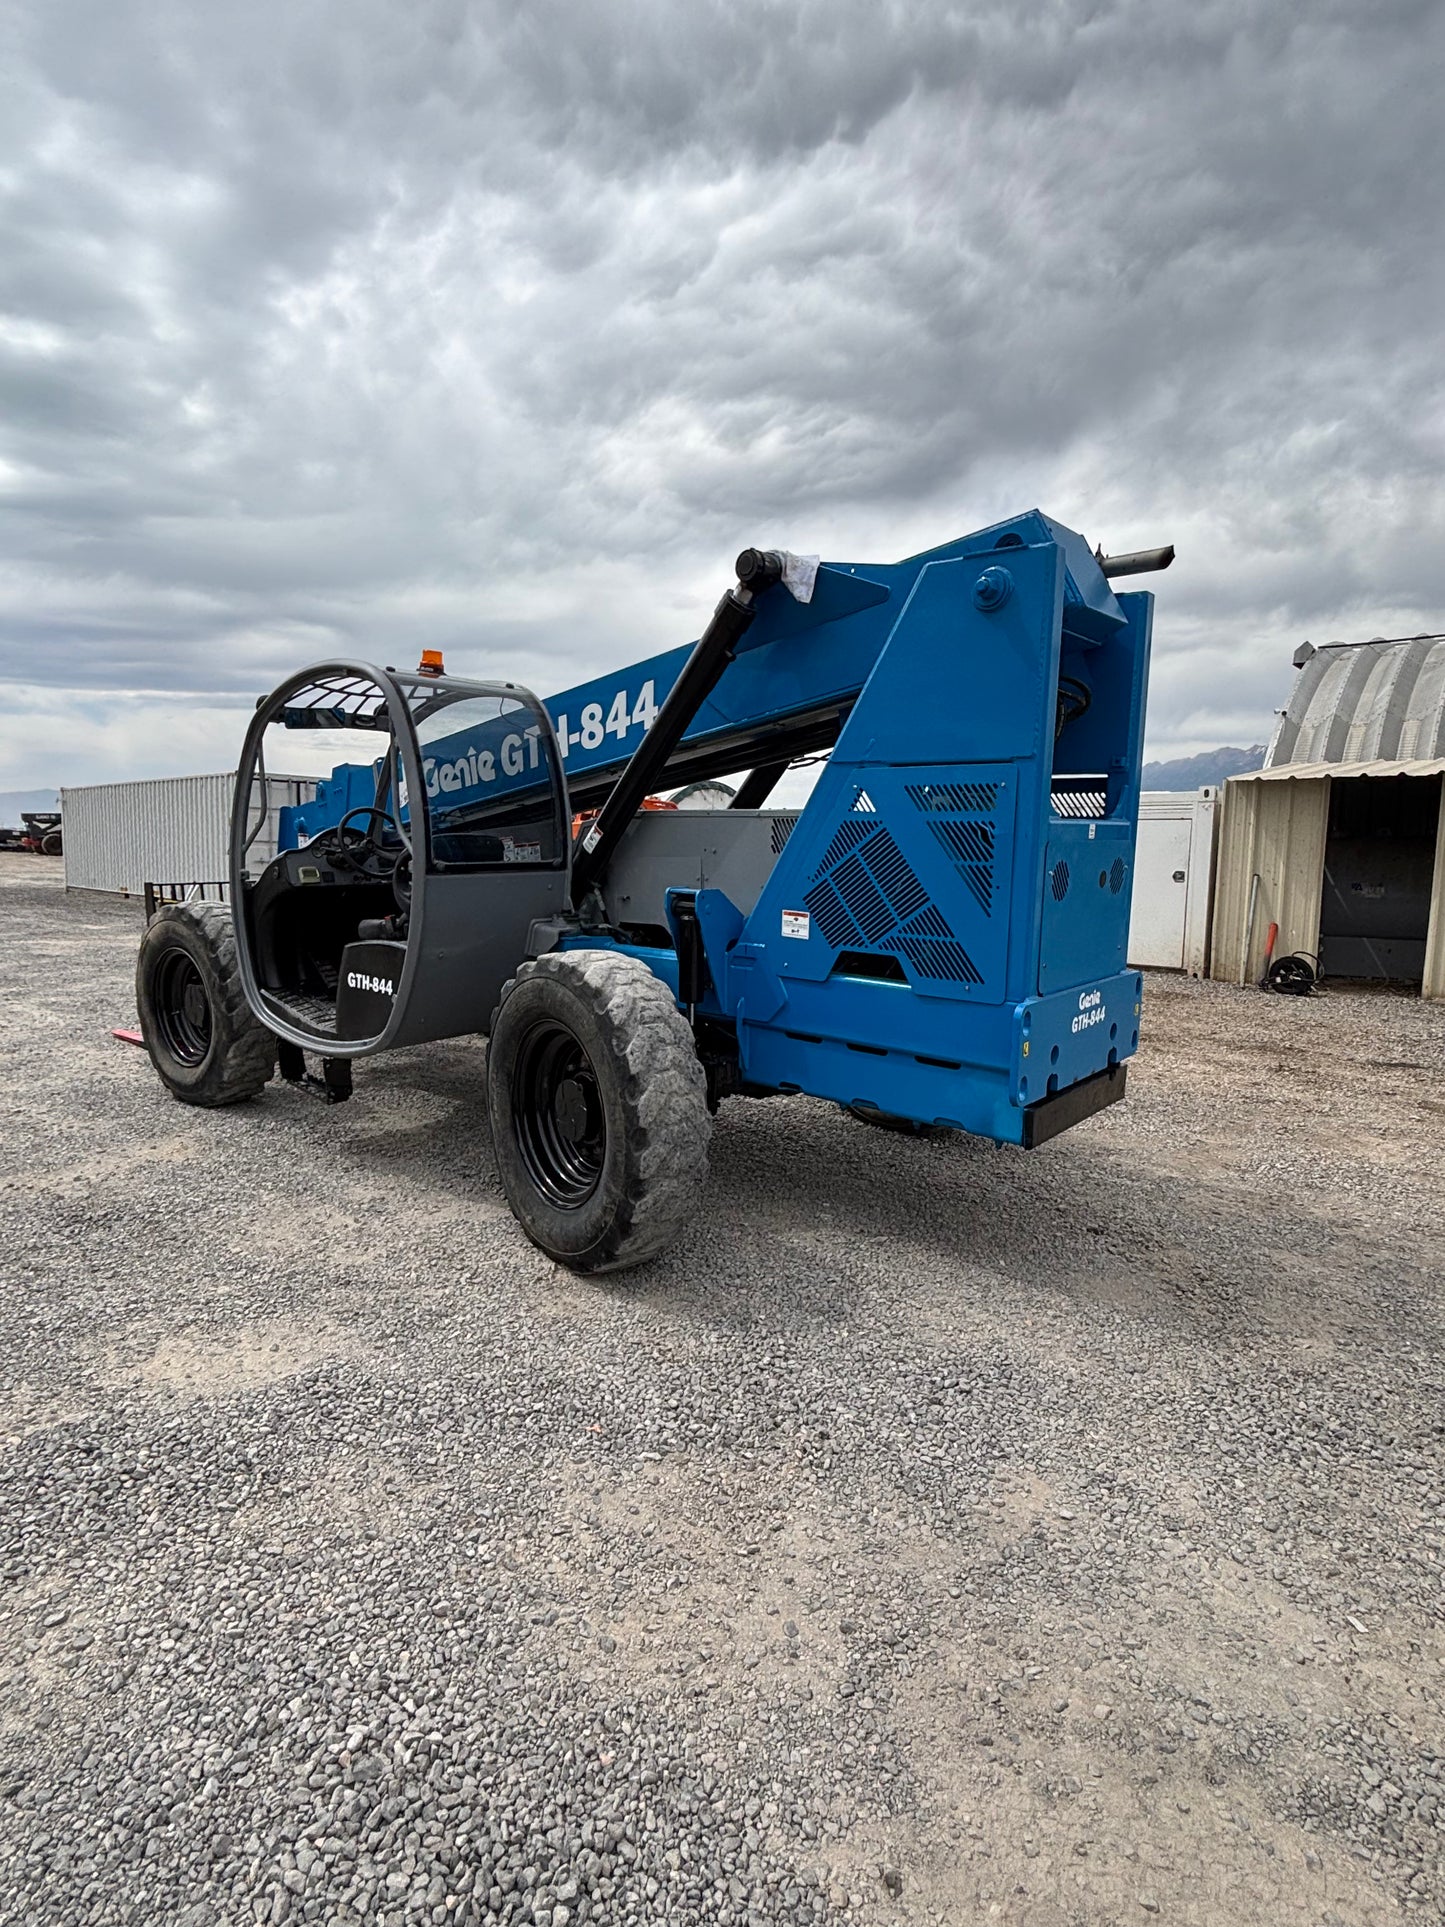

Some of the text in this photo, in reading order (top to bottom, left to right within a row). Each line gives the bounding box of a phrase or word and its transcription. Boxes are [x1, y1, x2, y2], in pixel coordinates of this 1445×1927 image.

[423, 746, 496, 798] Genie
[347, 972, 393, 996] GTH-844
[1079, 989, 1101, 1010] Genie
[1071, 1006, 1106, 1033] GTH-844
